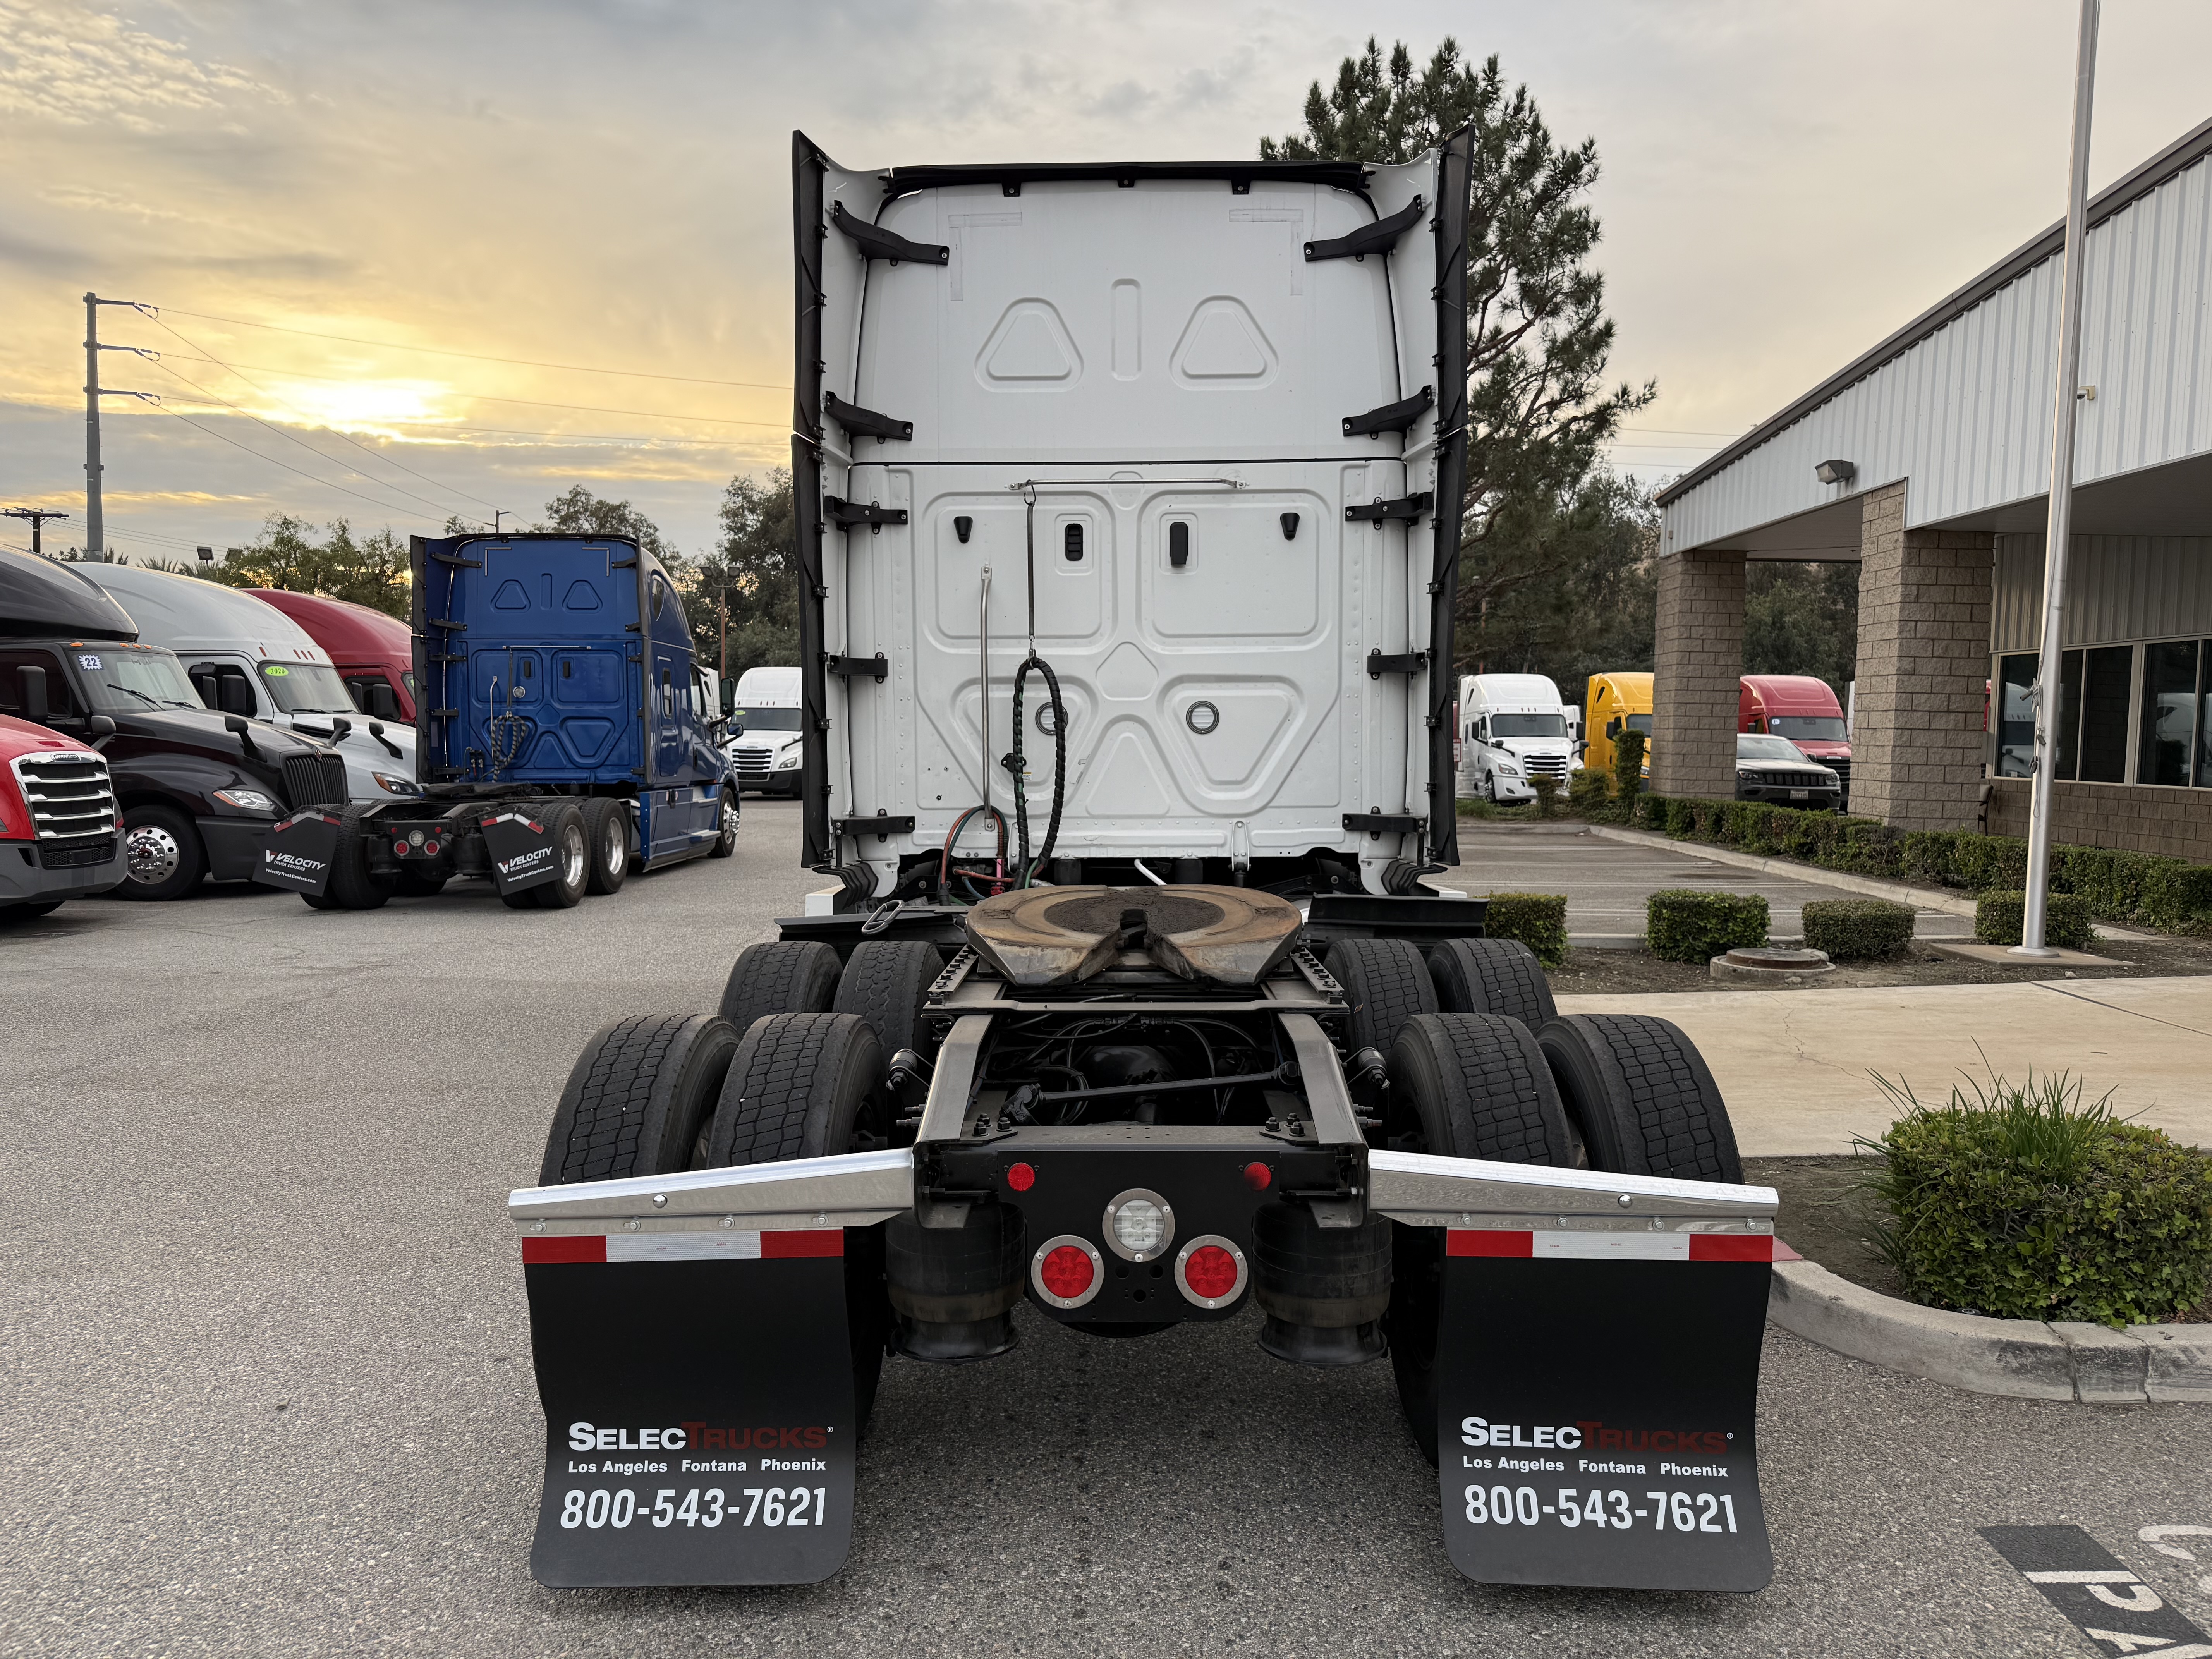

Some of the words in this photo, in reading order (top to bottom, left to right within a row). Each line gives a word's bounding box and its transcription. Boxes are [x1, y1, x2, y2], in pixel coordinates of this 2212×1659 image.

[85, 658, 98, 667] 22
[276, 853, 326, 870] VELOCITY
[510, 846, 553, 867] VELOCITY
[522, 859, 539, 868] CENTERS
[265, 868, 316, 883] VelocityTruckCenters.com
[507, 865, 554, 882] VelocityTruckCenters.com
[568, 1461, 597, 1473] Los
[602, 1460, 668, 1475] Angeles
[682, 1460, 747, 1472] Fontana
[761, 1458, 826, 1471] Phoenix
[1463, 1455, 1492, 1468] Los
[1498, 1456, 1565, 1473] Angeles
[1579, 1460, 1646, 1474] Fontana
[1660, 1462, 1728, 1477] Phoenix
[560, 1487, 826, 1529] 800-543-7621
[1465, 1484, 1738, 1533] 800-543-7621
